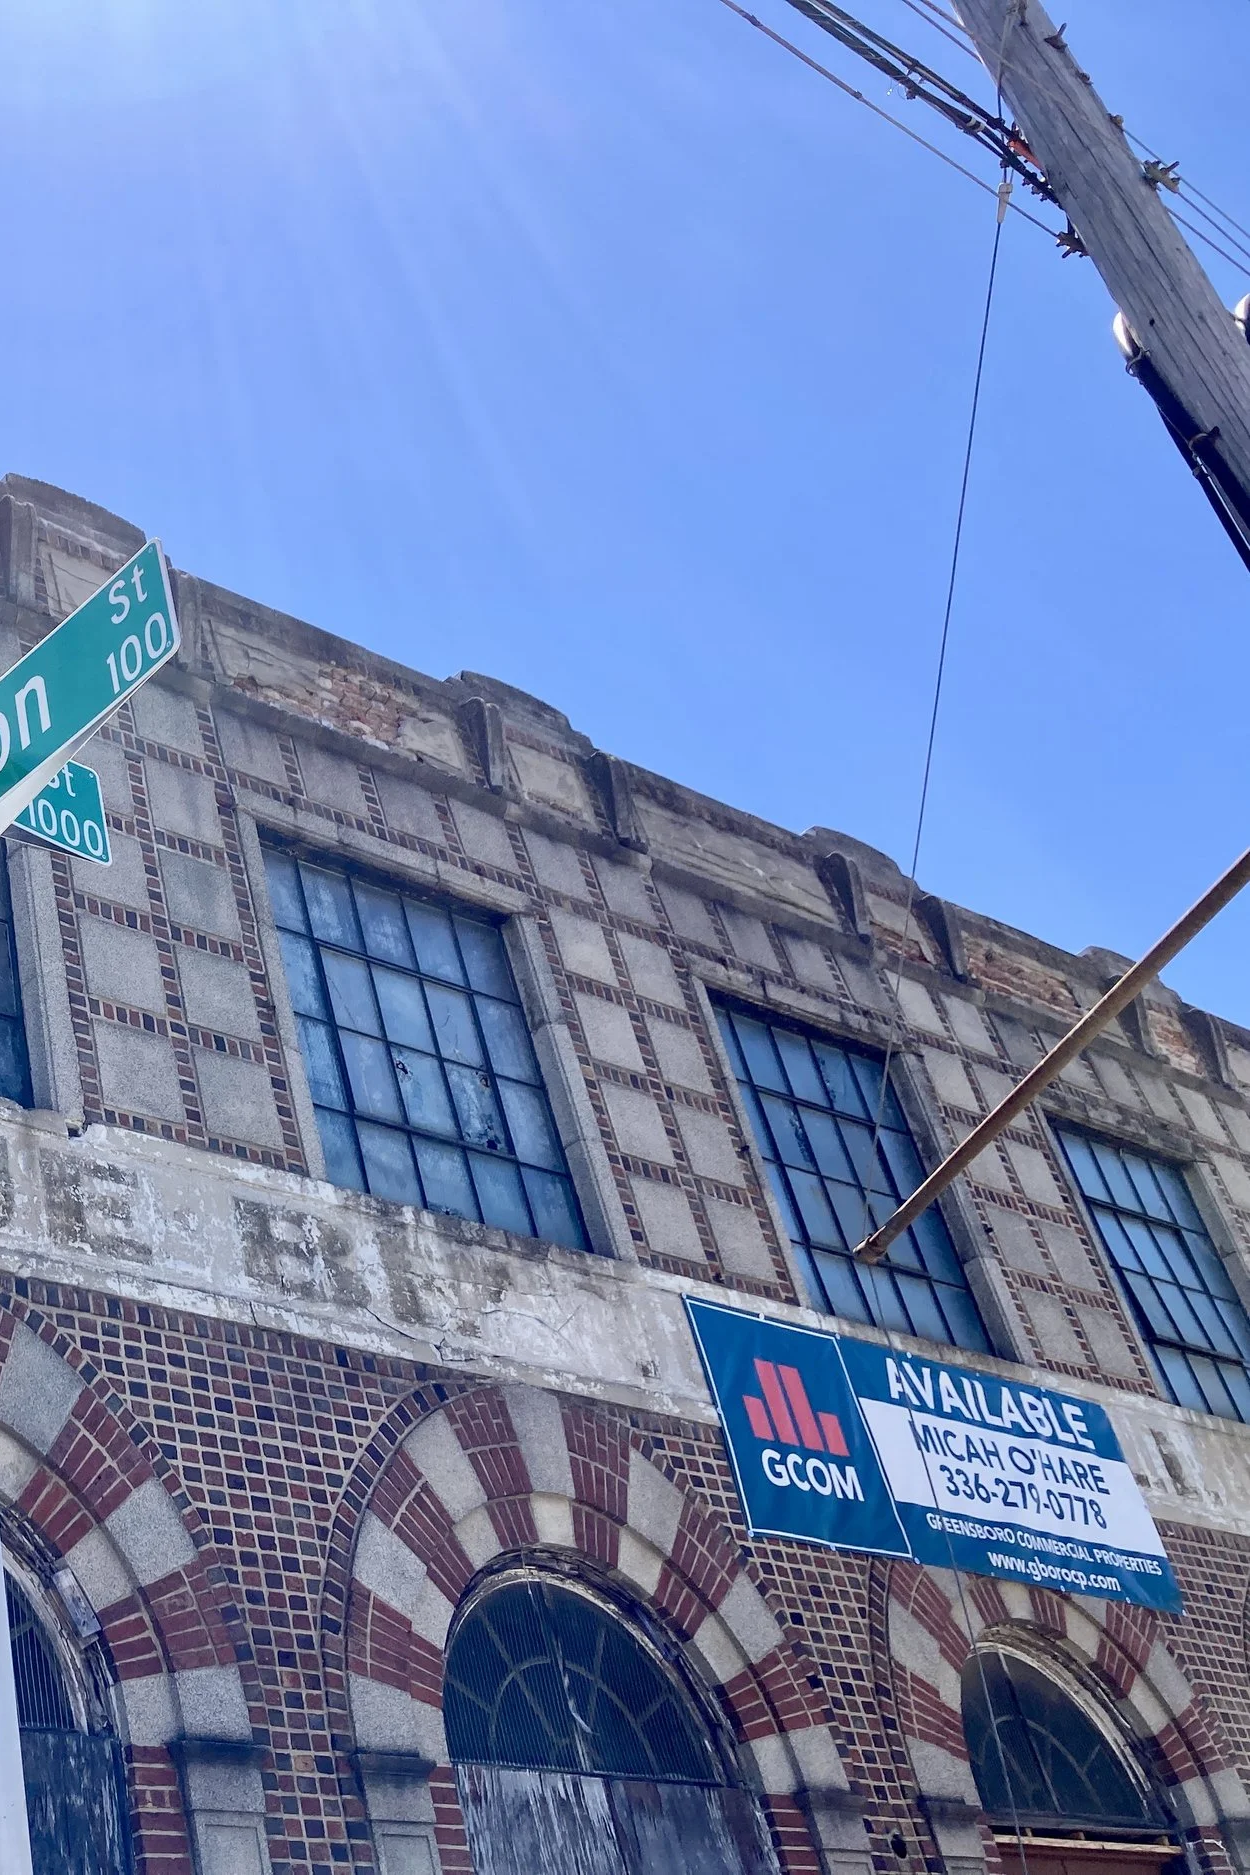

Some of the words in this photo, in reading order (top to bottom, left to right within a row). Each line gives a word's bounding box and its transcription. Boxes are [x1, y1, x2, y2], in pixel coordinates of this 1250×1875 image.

[108, 562, 148, 624] St
[105, 612, 168, 695] 100
[29, 799, 103, 857] 1000
[886, 1357, 1096, 1450] AVAILABLE
[761, 1448, 864, 1502] GCOM
[909, 1420, 1005, 1471] MICAH
[1009, 1446, 1110, 1495] O'HARE
[939, 1464, 1107, 1529] 336-279-0778
[987, 1552, 1122, 1592] www.gborocp.com
[1017, 1531, 1093, 1562] COMMERCIAL
[1095, 1552, 1162, 1576] PROPERTIES
